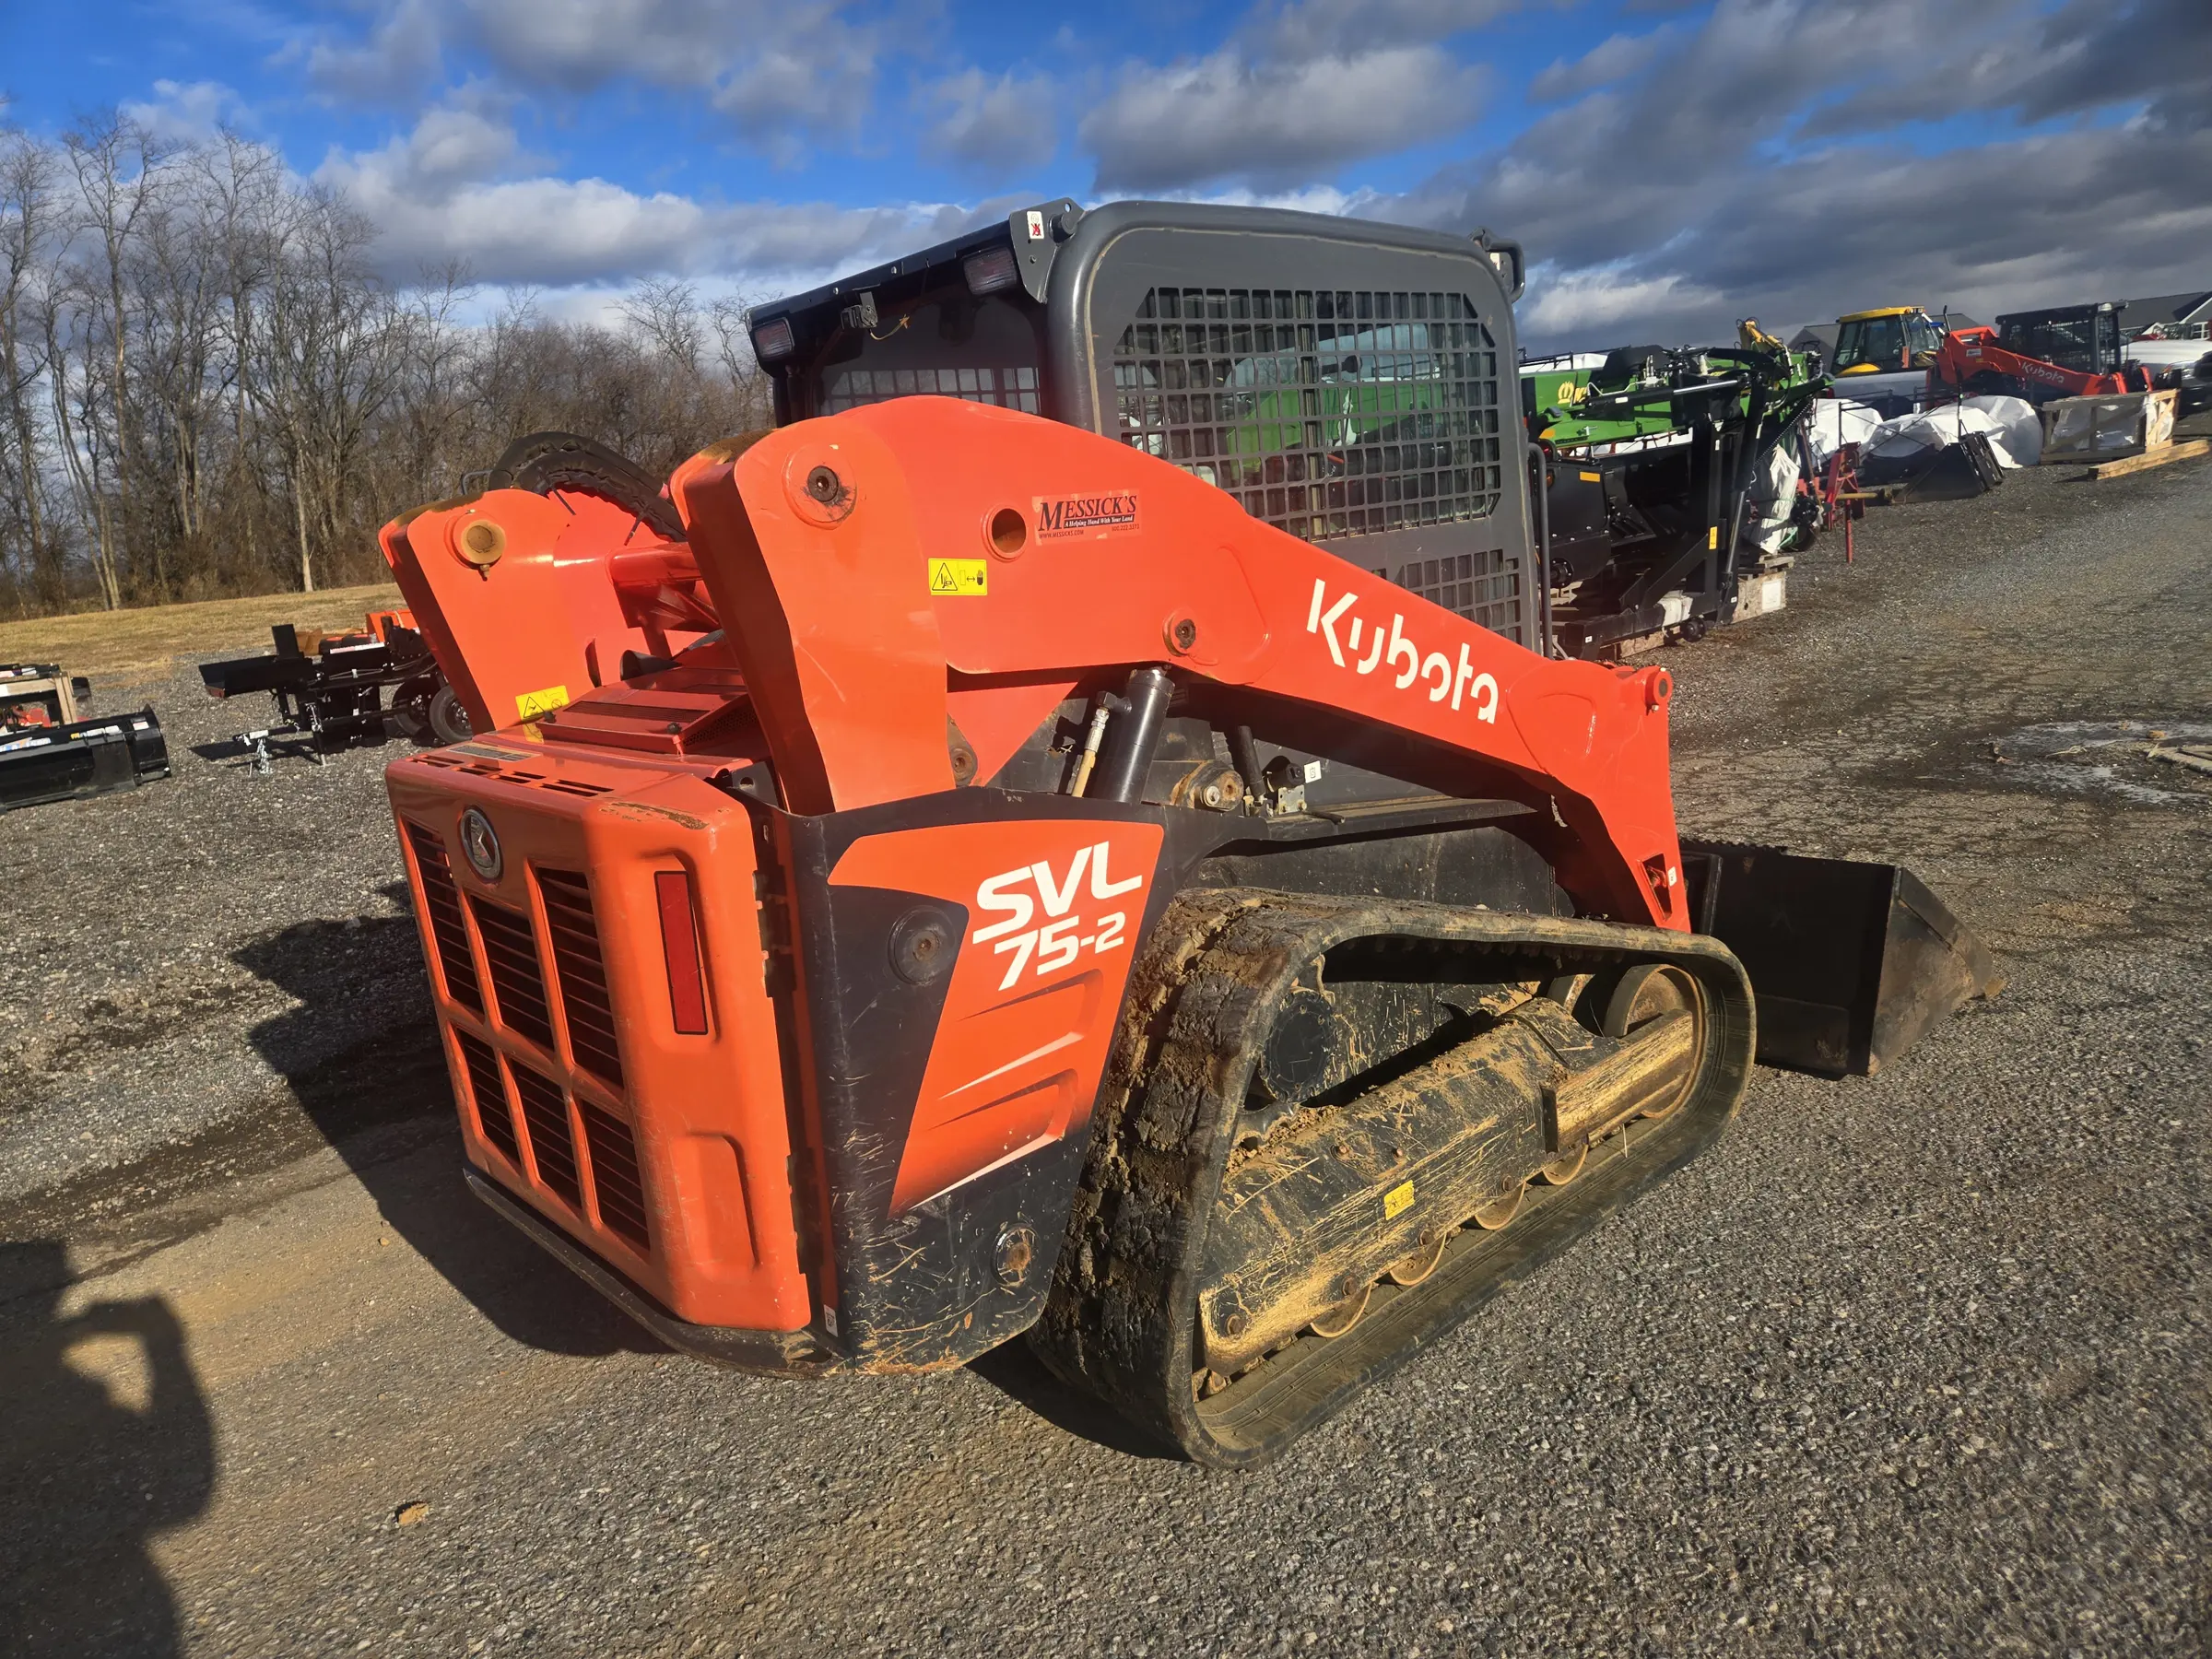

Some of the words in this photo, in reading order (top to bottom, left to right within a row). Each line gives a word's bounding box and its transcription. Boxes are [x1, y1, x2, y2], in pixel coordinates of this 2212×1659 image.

[2021, 361, 2065, 383] Kubota
[1038, 495, 1137, 532] MESSICK'S
[1307, 578, 1499, 724] Kubota
[972, 841, 1142, 945] SVL
[994, 912, 1126, 992] 75-2
